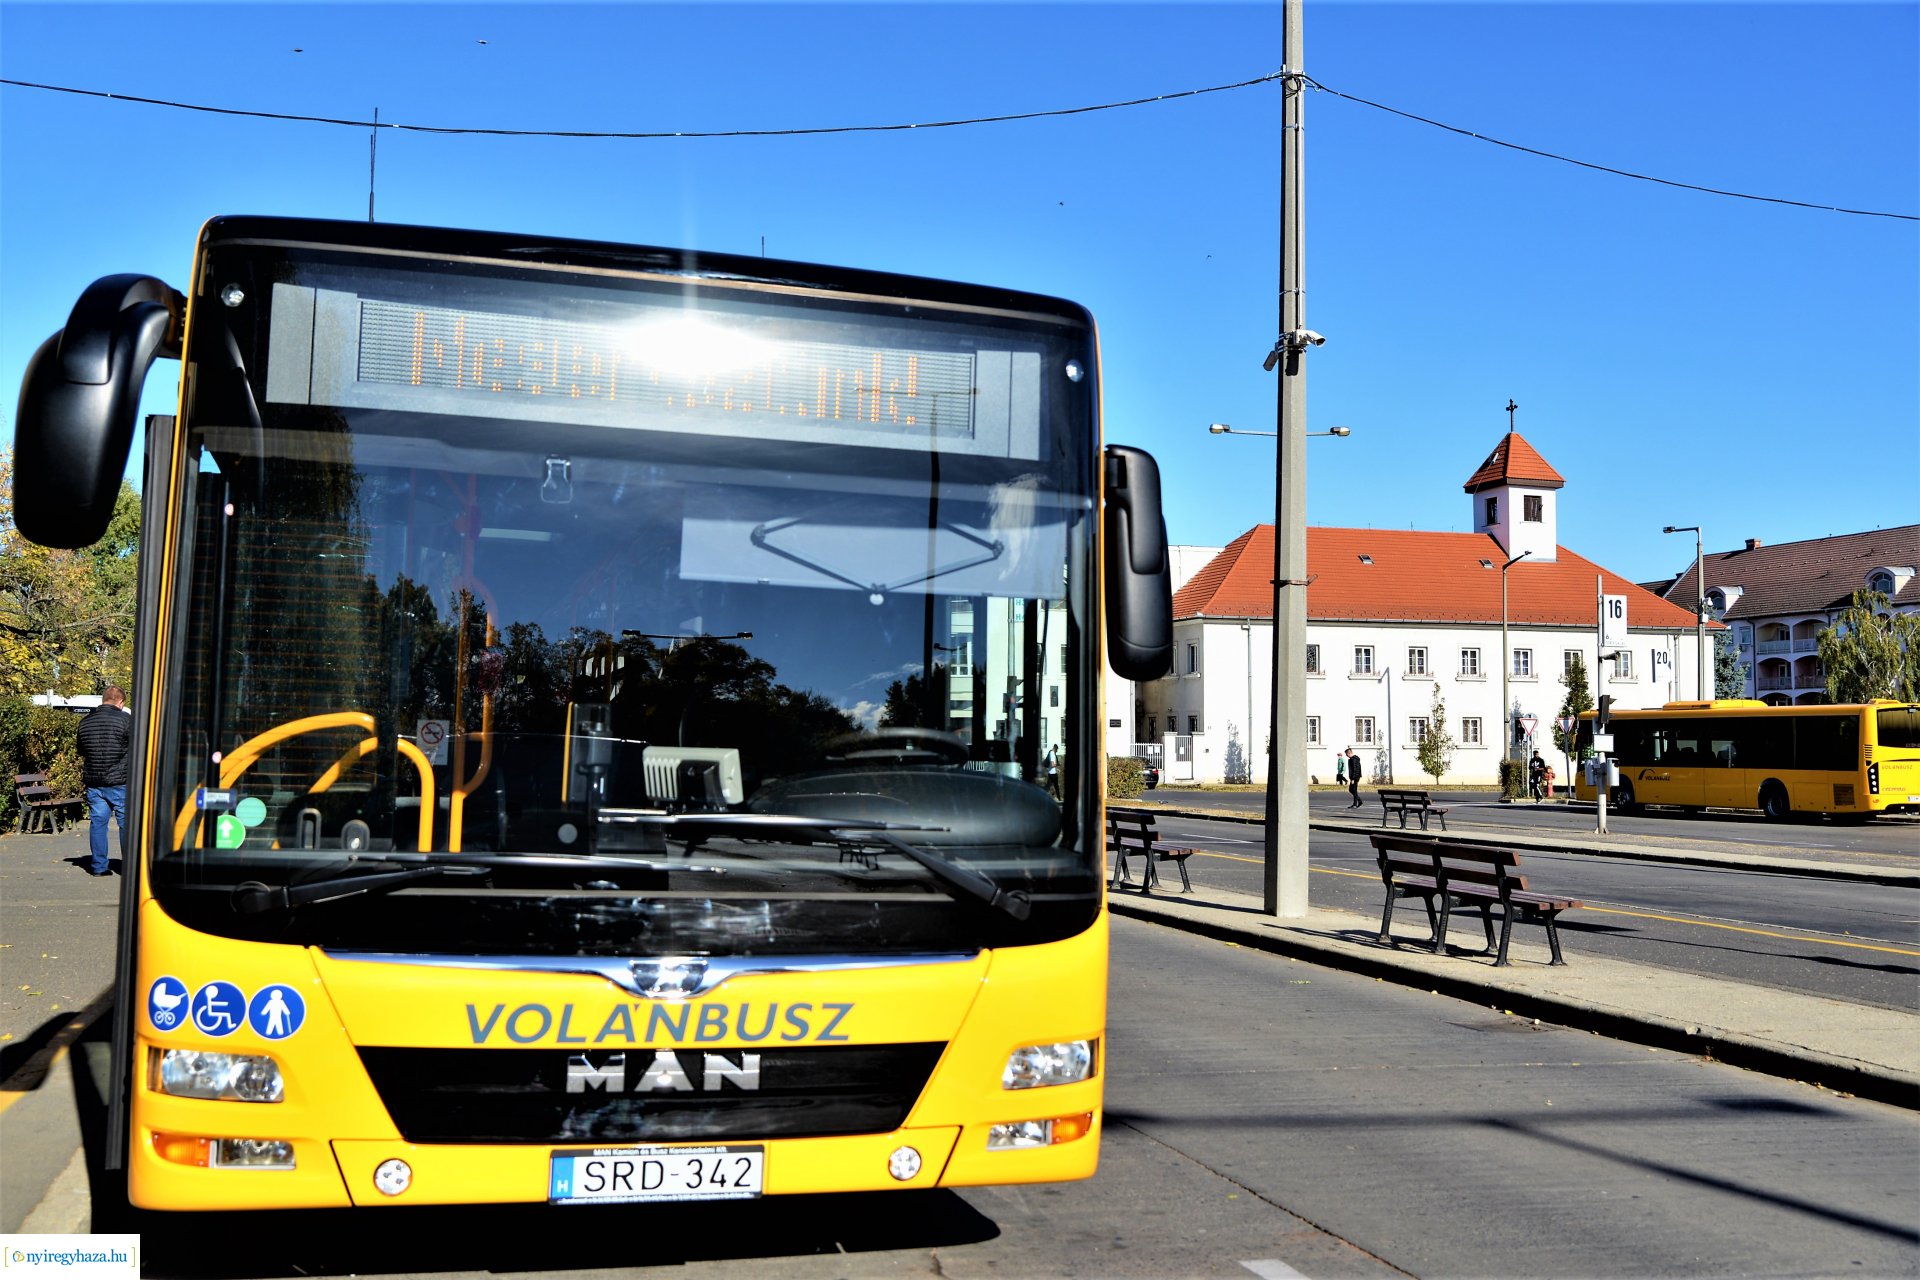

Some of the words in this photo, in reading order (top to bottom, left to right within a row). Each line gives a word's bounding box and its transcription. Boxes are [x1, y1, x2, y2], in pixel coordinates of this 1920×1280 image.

[1608, 599, 1622, 619] 16
[1656, 651, 1668, 665] 20
[566, 1051, 761, 1093] MAN
[557, 1179, 569, 1193] H
[583, 1157, 752, 1192] SRD-342
